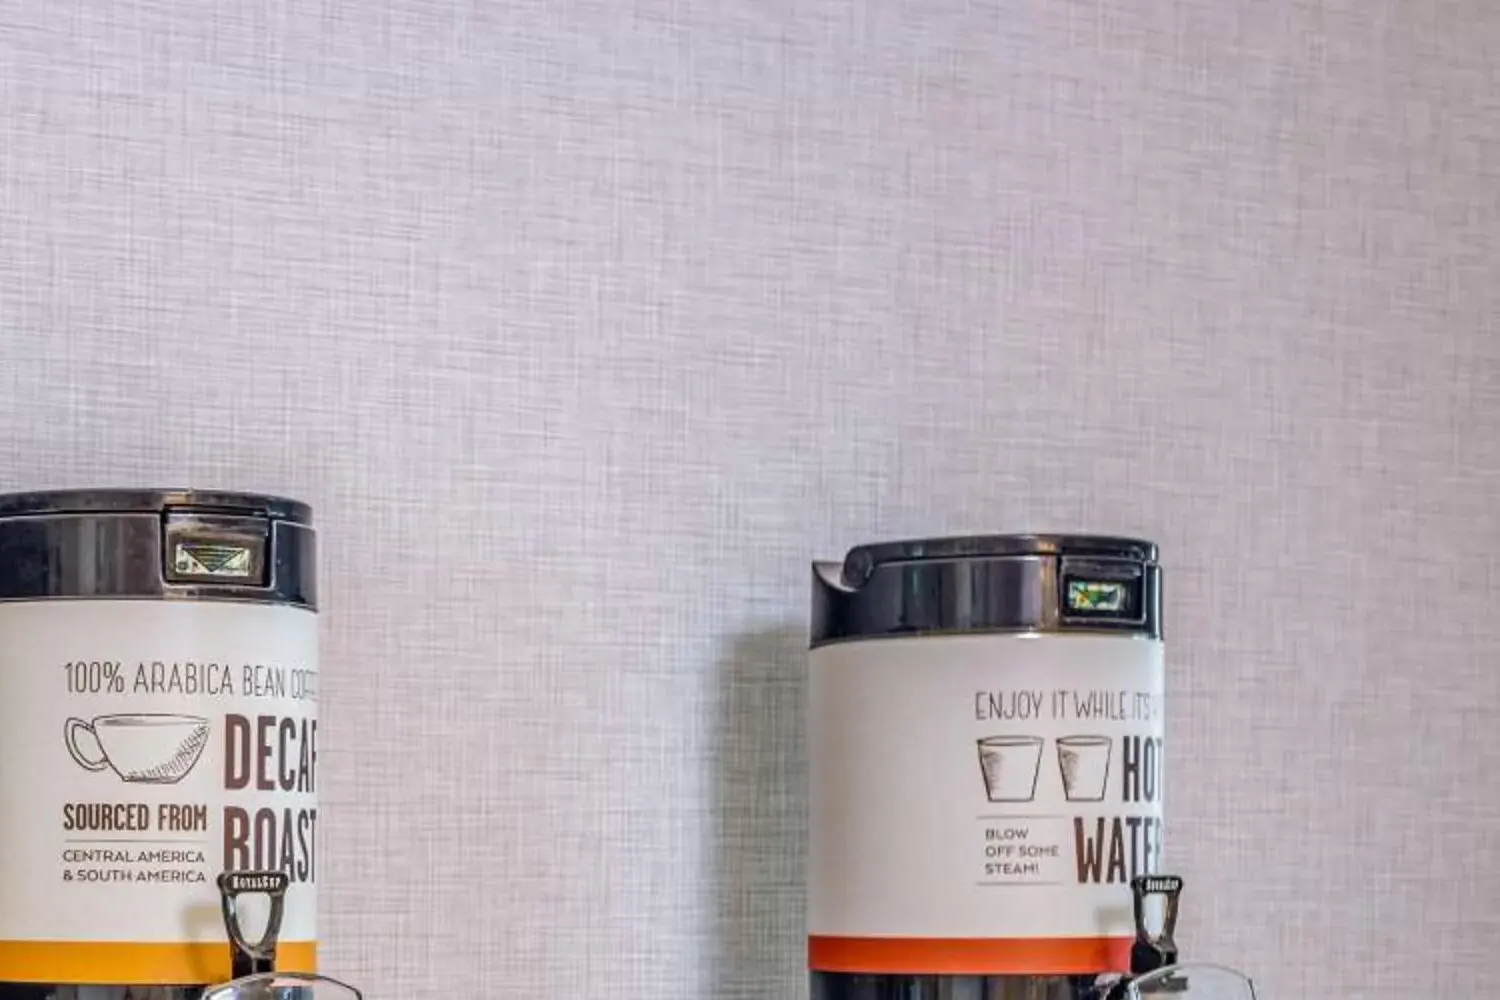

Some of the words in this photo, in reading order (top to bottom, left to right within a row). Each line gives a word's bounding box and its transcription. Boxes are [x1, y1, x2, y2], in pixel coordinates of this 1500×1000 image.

[64, 661, 124, 694] 100%
[133, 662, 233, 695] ARABICA
[242, 665, 286, 698] BEAN
[976, 691, 1042, 720] ENJOY
[1052, 691, 1069, 720] IT
[1073, 691, 1126, 720] WHILE
[63, 803, 149, 831] SOURCED
[157, 804, 207, 832] FROM
[223, 805, 317, 884] ROAST
[985, 828, 1029, 840] BLOW
[63, 849, 133, 863] CENTRAL
[137, 850, 205, 863] AMERICA
[985, 845, 1014, 858] OFF
[1019, 845, 1059, 857] SOME
[63, 869, 73, 882] &
[77, 869, 132, 882] SOUTH
[136, 870, 206, 883] AMERICA
